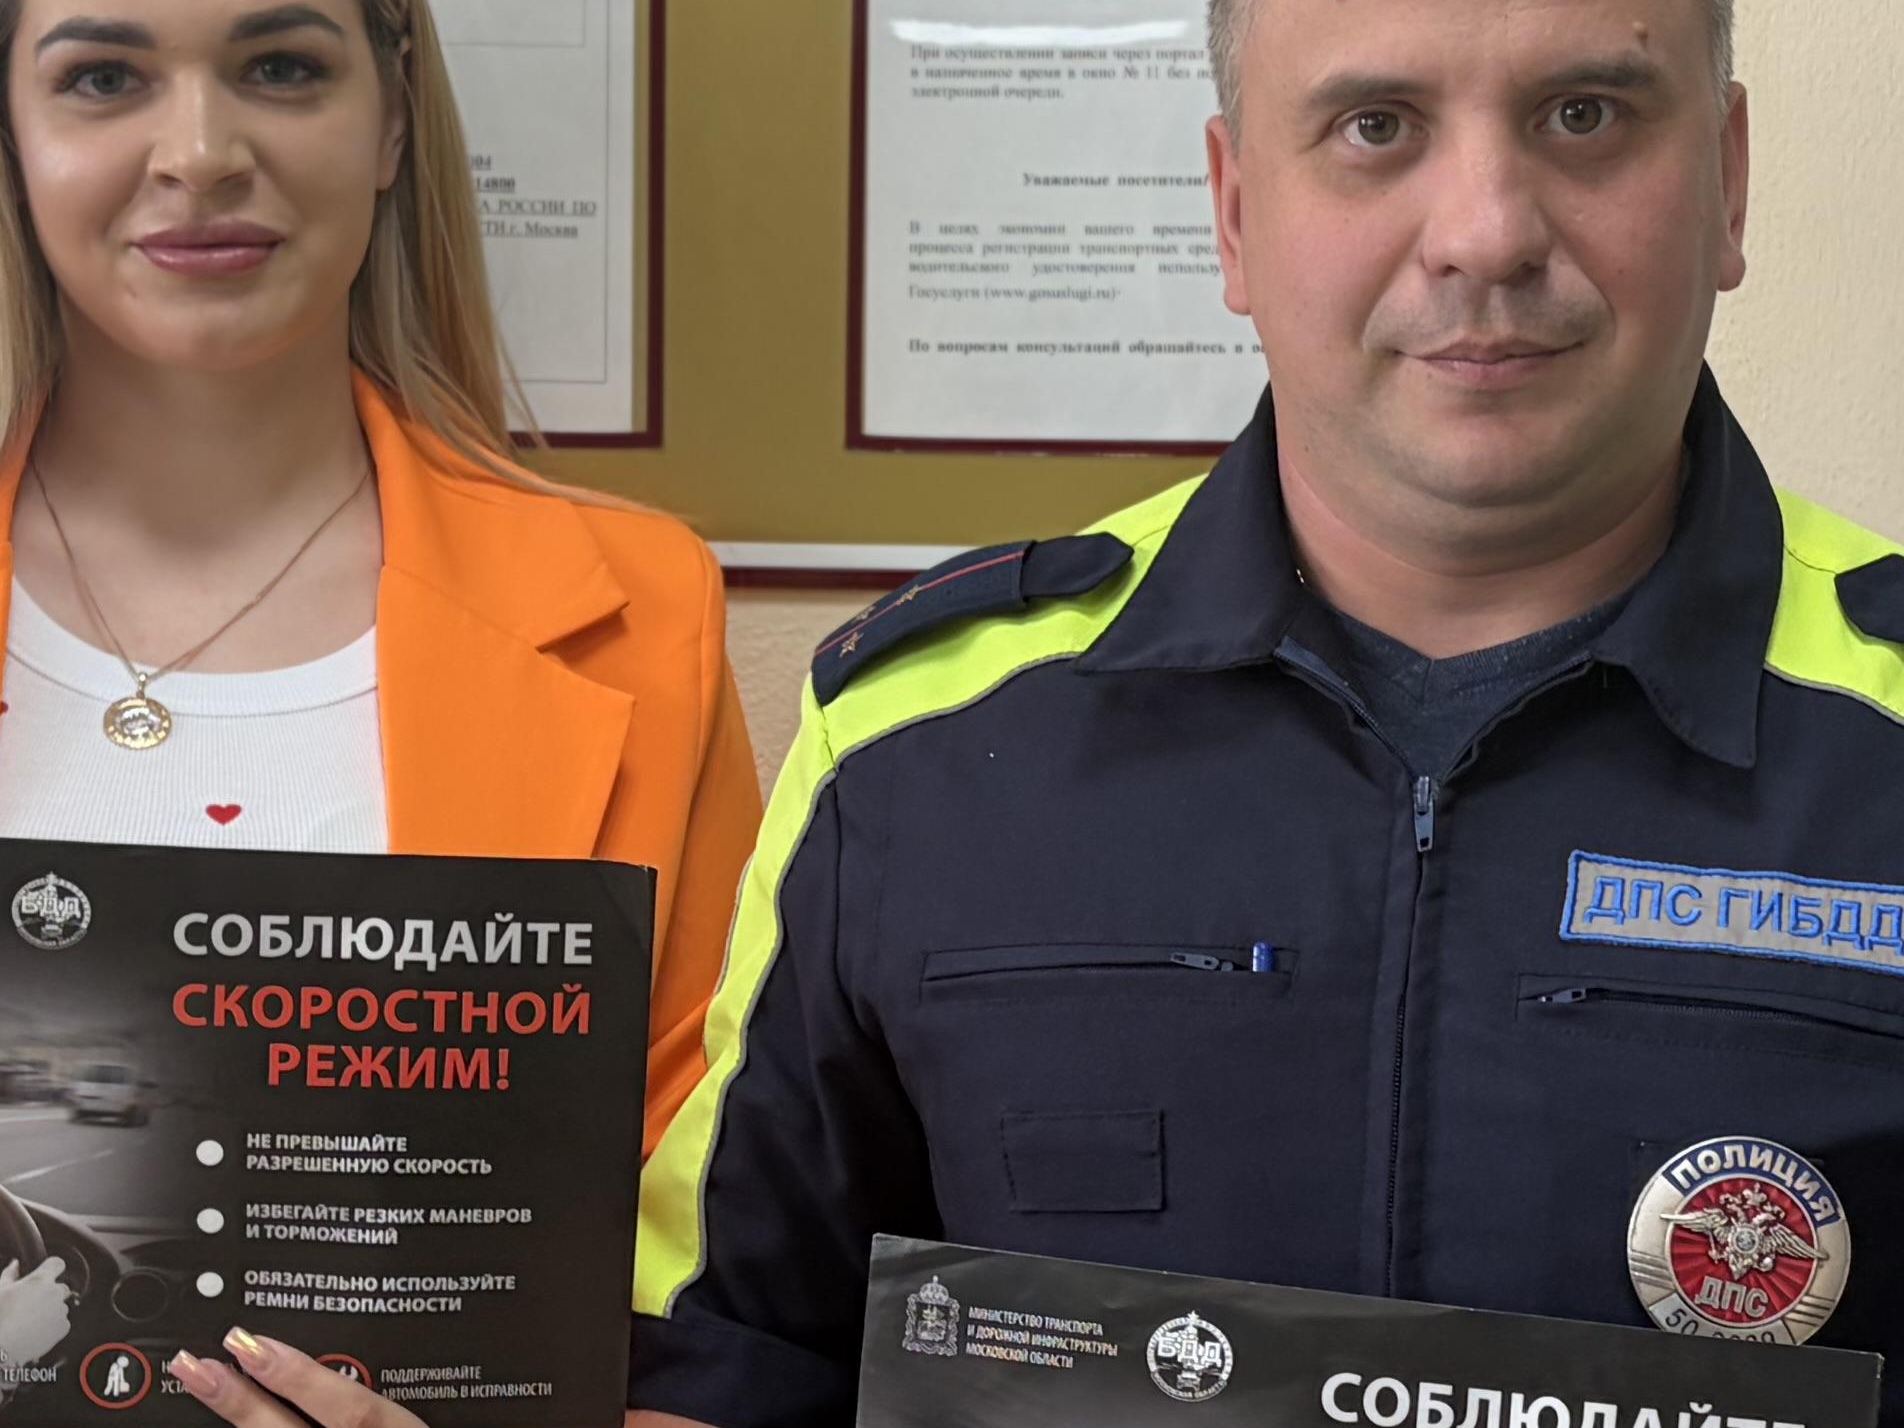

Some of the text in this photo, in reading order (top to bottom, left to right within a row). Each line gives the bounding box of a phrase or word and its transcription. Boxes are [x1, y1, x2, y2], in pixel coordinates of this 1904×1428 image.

[1023, 172, 1110, 187] Уважаемые
[908, 337, 931, 353] По
[936, 341, 1009, 357] вопросам
[1015, 340, 1121, 356] консультаций
[1128, 339, 1226, 357] обращайтесь
[1584, 876, 1703, 926] ДПС
[174, 912, 592, 971] СОБЛЮДАЙТЕ
[173, 983, 590, 1035] СКОРОСТНОЙ
[268, 1042, 509, 1090] РЕЖИМ!
[246, 1132, 408, 1153] НЕ ПРЕВЫШАЙТЕ
[246, 1154, 492, 1175] РАЗРЕШЕННУЮ СКОРОСТЬ
[1670, 1144, 1836, 1222] ПОЛИЦИЯ
[245, 1203, 532, 1226] ИЗБЕГАЙТЕ РЕЗКИХ МАНЕВРОВ
[245, 1223, 399, 1245] И ТОРМОЖЕНИЙ
[244, 1270, 516, 1293] ОБЯЗАТЕЛЬНО ИСПОЛЬЗУЙТЕ
[244, 1290, 462, 1314] РЕМНИ БЕЗОПАСНОСТИ
[1695, 1275, 1769, 1318] ДПС
[969, 1306, 1104, 1337] МИНИСТЕРСТВО ТРАНСПОРТА
[976, 1324, 1030, 1347] ДОРОЖНОЙ
[1031, 1333, 1118, 1357] ИНФРАСТРУКТУРЫ
[965, 1343, 1074, 1369] МОСКОВСКОЙ ОБЛАСТИ
[3, 1367, 57, 1383] ТЕЛЕФОН
[381, 1366, 482, 1383] ПОДДЕРЖИВАЙТЕ
[460, 1384, 469, 1398] В
[470, 1382, 553, 1398] ИСПРАВНОСТИ
